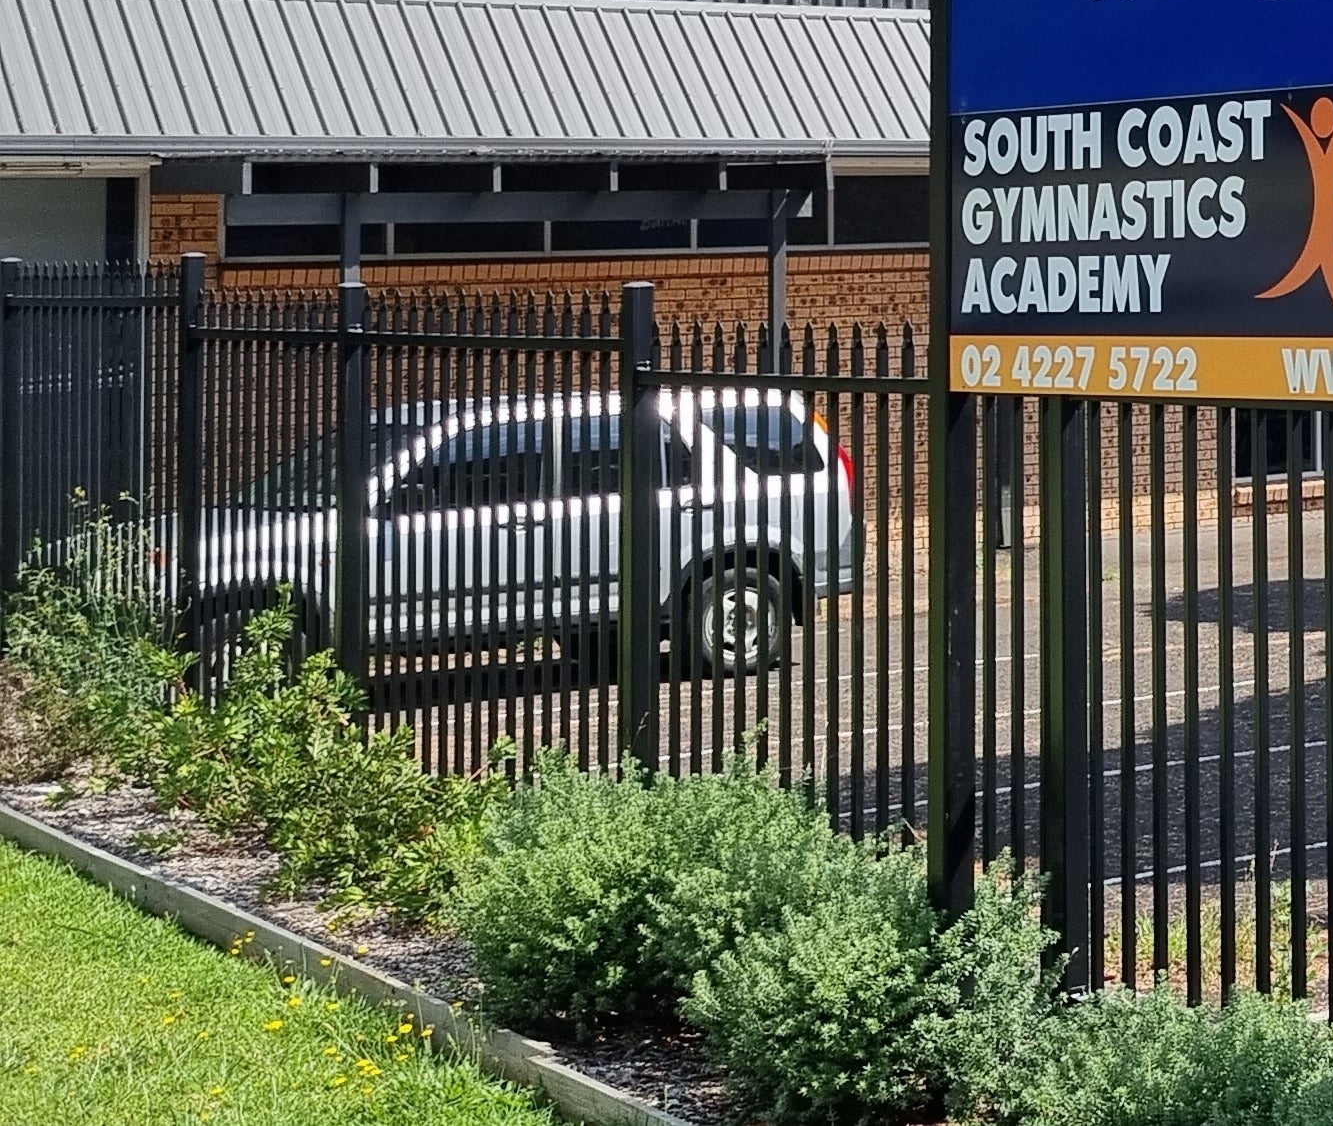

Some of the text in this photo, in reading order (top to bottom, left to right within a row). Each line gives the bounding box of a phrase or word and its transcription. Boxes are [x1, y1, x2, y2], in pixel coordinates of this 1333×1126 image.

[962, 99, 1273, 177] SOUTH COAST
[961, 176, 1247, 246] GYMNASTICS
[961, 254, 1172, 315] ACADEMY
[961, 344, 1199, 392] 02 4227 5722
